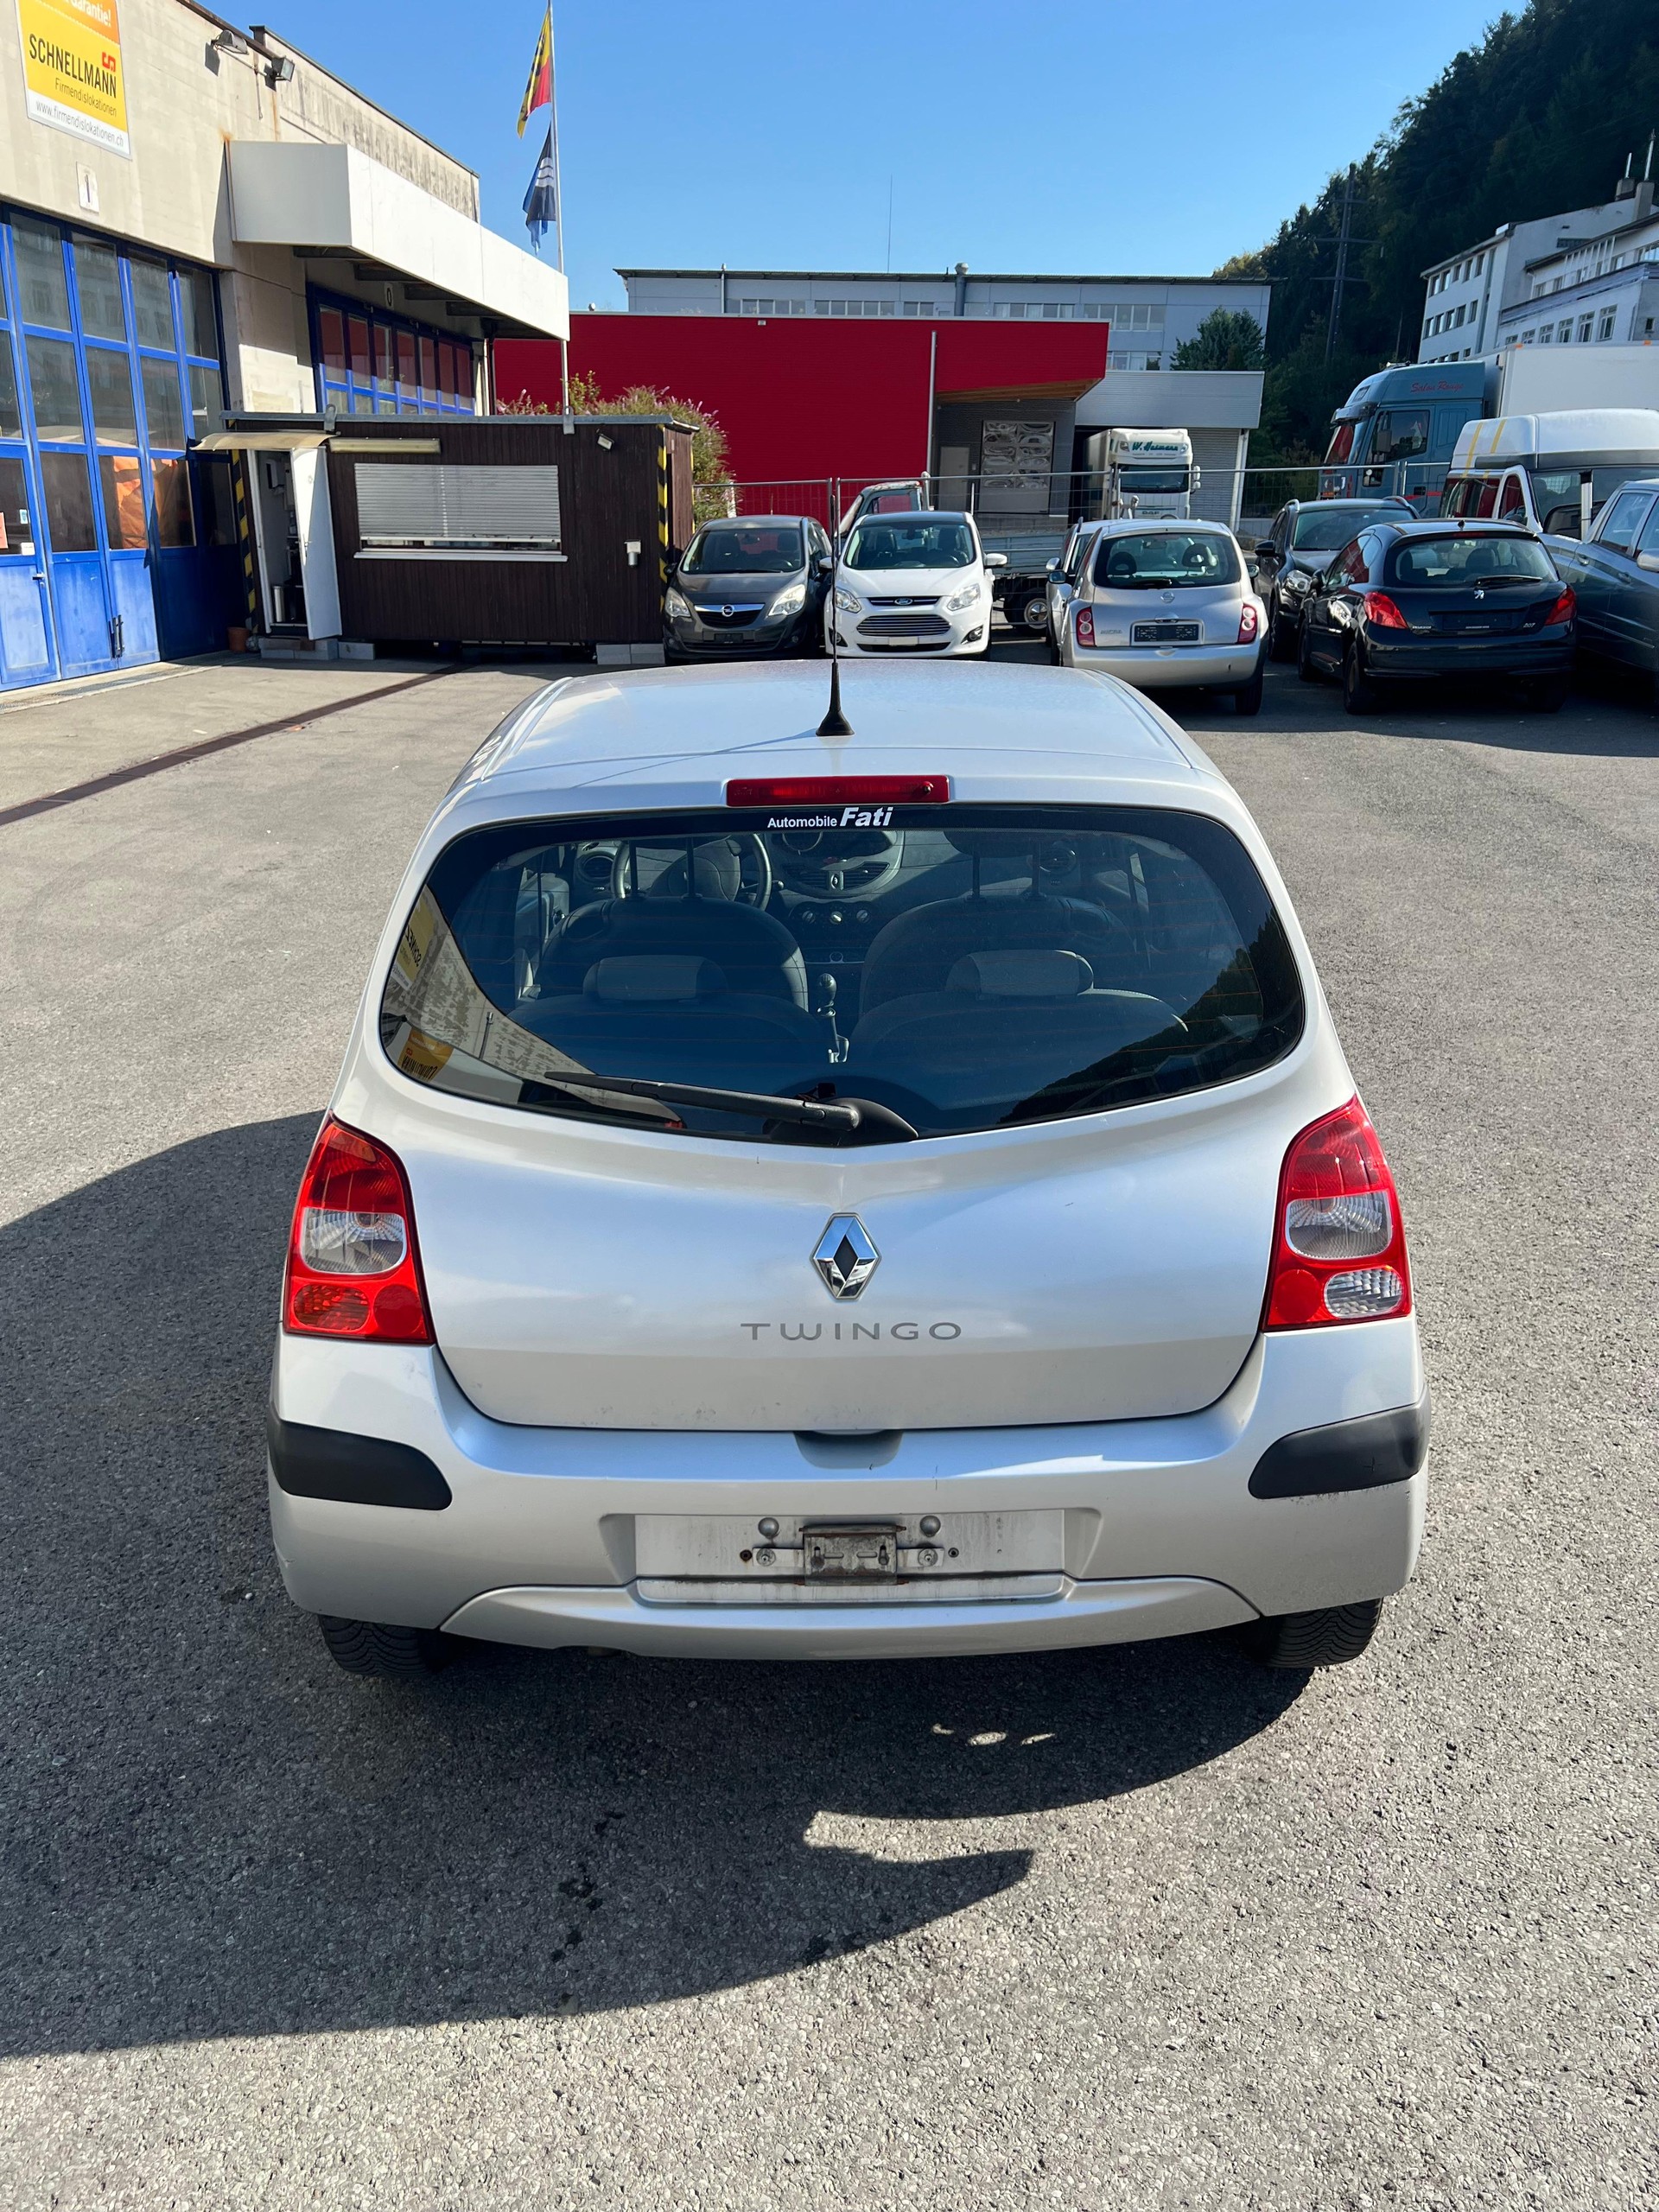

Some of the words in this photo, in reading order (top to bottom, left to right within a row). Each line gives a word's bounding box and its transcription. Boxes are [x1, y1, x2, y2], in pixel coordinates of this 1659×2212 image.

[29, 33, 117, 99] SCHNELLMANN
[54, 77, 118, 118] Firmendislokationen
[35, 101, 124, 147] www.firmendislokationen.ch
[767, 816, 837, 828] Automobile
[839, 806, 893, 827] Fati
[741, 1322, 962, 1340] TWINGO
